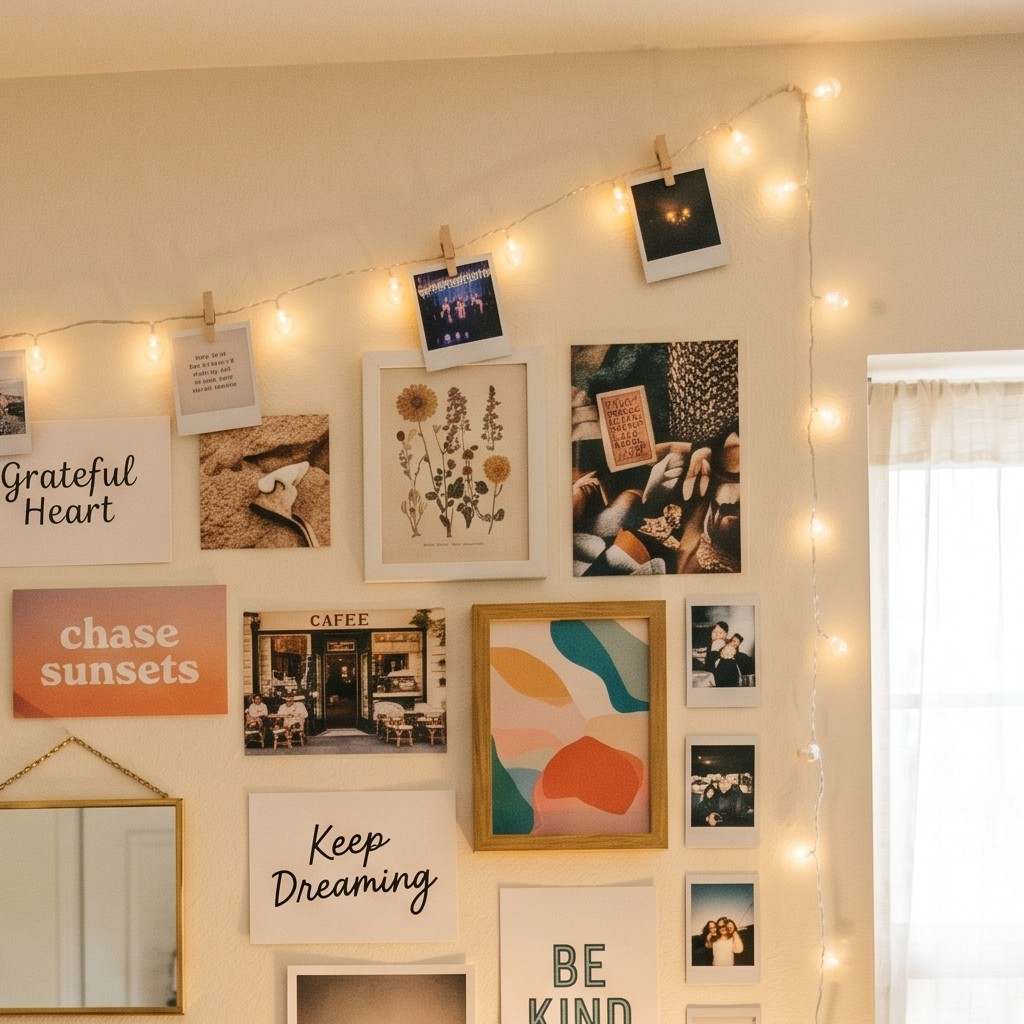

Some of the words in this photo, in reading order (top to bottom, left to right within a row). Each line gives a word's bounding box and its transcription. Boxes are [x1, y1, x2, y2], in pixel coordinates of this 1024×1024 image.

[1, 454, 138, 503] Grateful
[24, 495, 116, 526] Heart
[60, 616, 179, 650] chase
[310, 612, 370, 627] CAFEE
[40, 654, 200, 687] sunsets
[308, 823, 391, 868] Keep
[271, 868, 438, 915] Dreaming
[553, 943, 606, 988] BE
